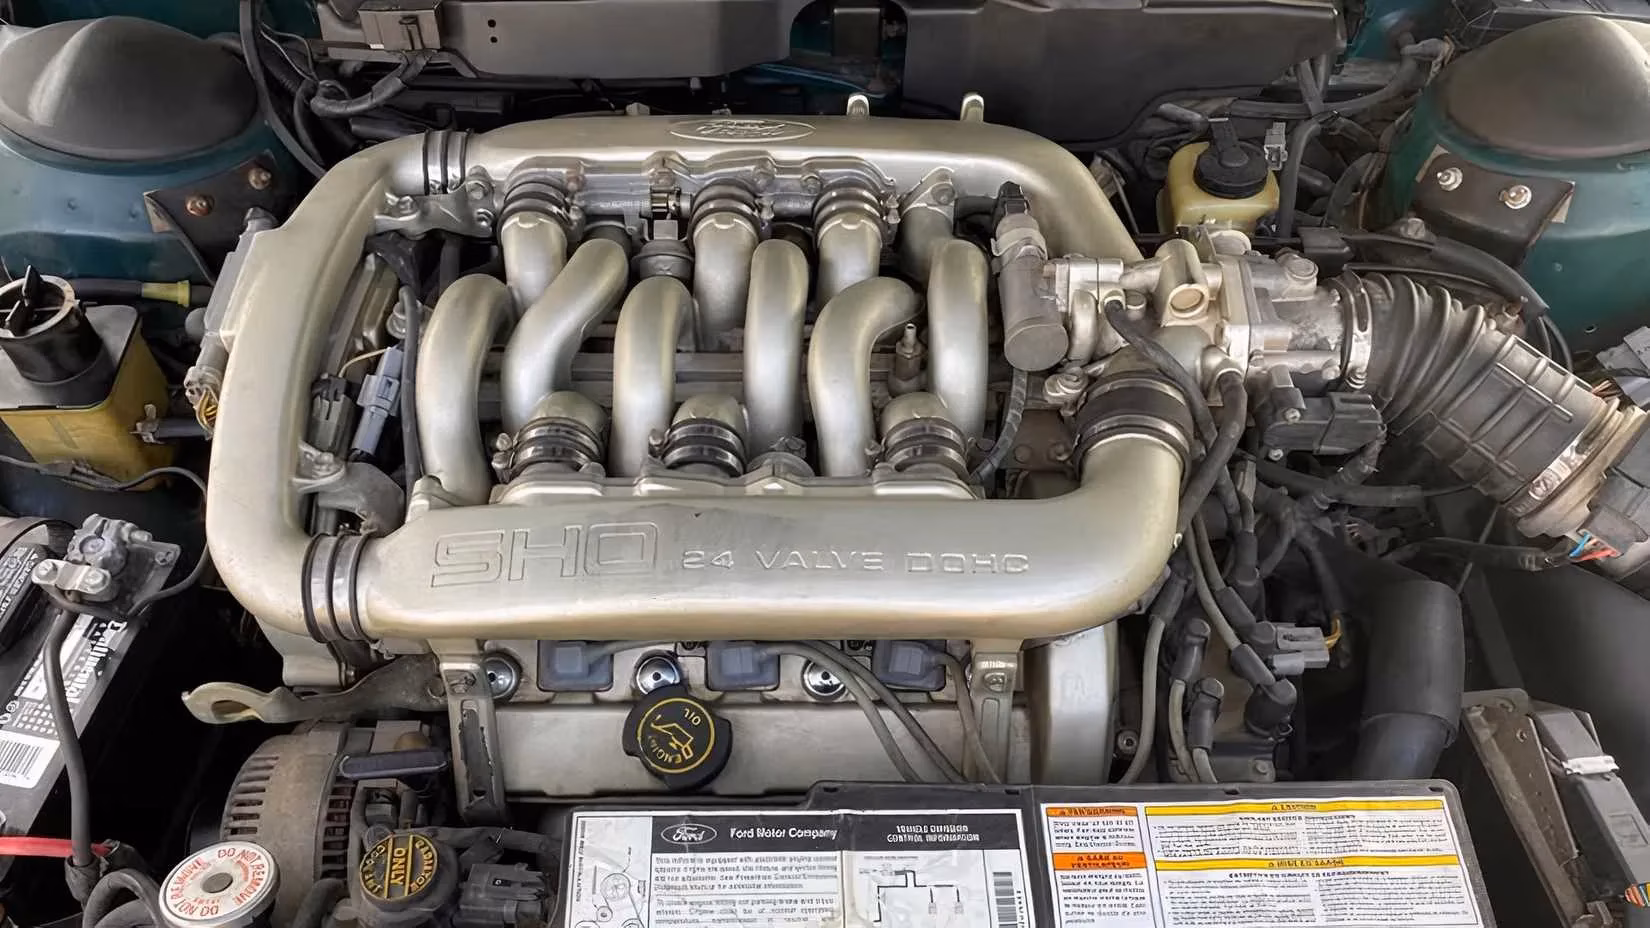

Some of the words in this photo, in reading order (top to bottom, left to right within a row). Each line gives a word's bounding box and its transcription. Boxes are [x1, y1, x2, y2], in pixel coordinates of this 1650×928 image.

[431, 522, 660, 588] SHO
[682, 550, 735, 570] 24
[753, 550, 884, 571] VALVE
[683, 708, 702, 726] OIL
[730, 827, 754, 839] Ford
[217, 847, 237, 859] DO
[390, 847, 407, 886] ONLY
[200, 904, 220, 917] DO
